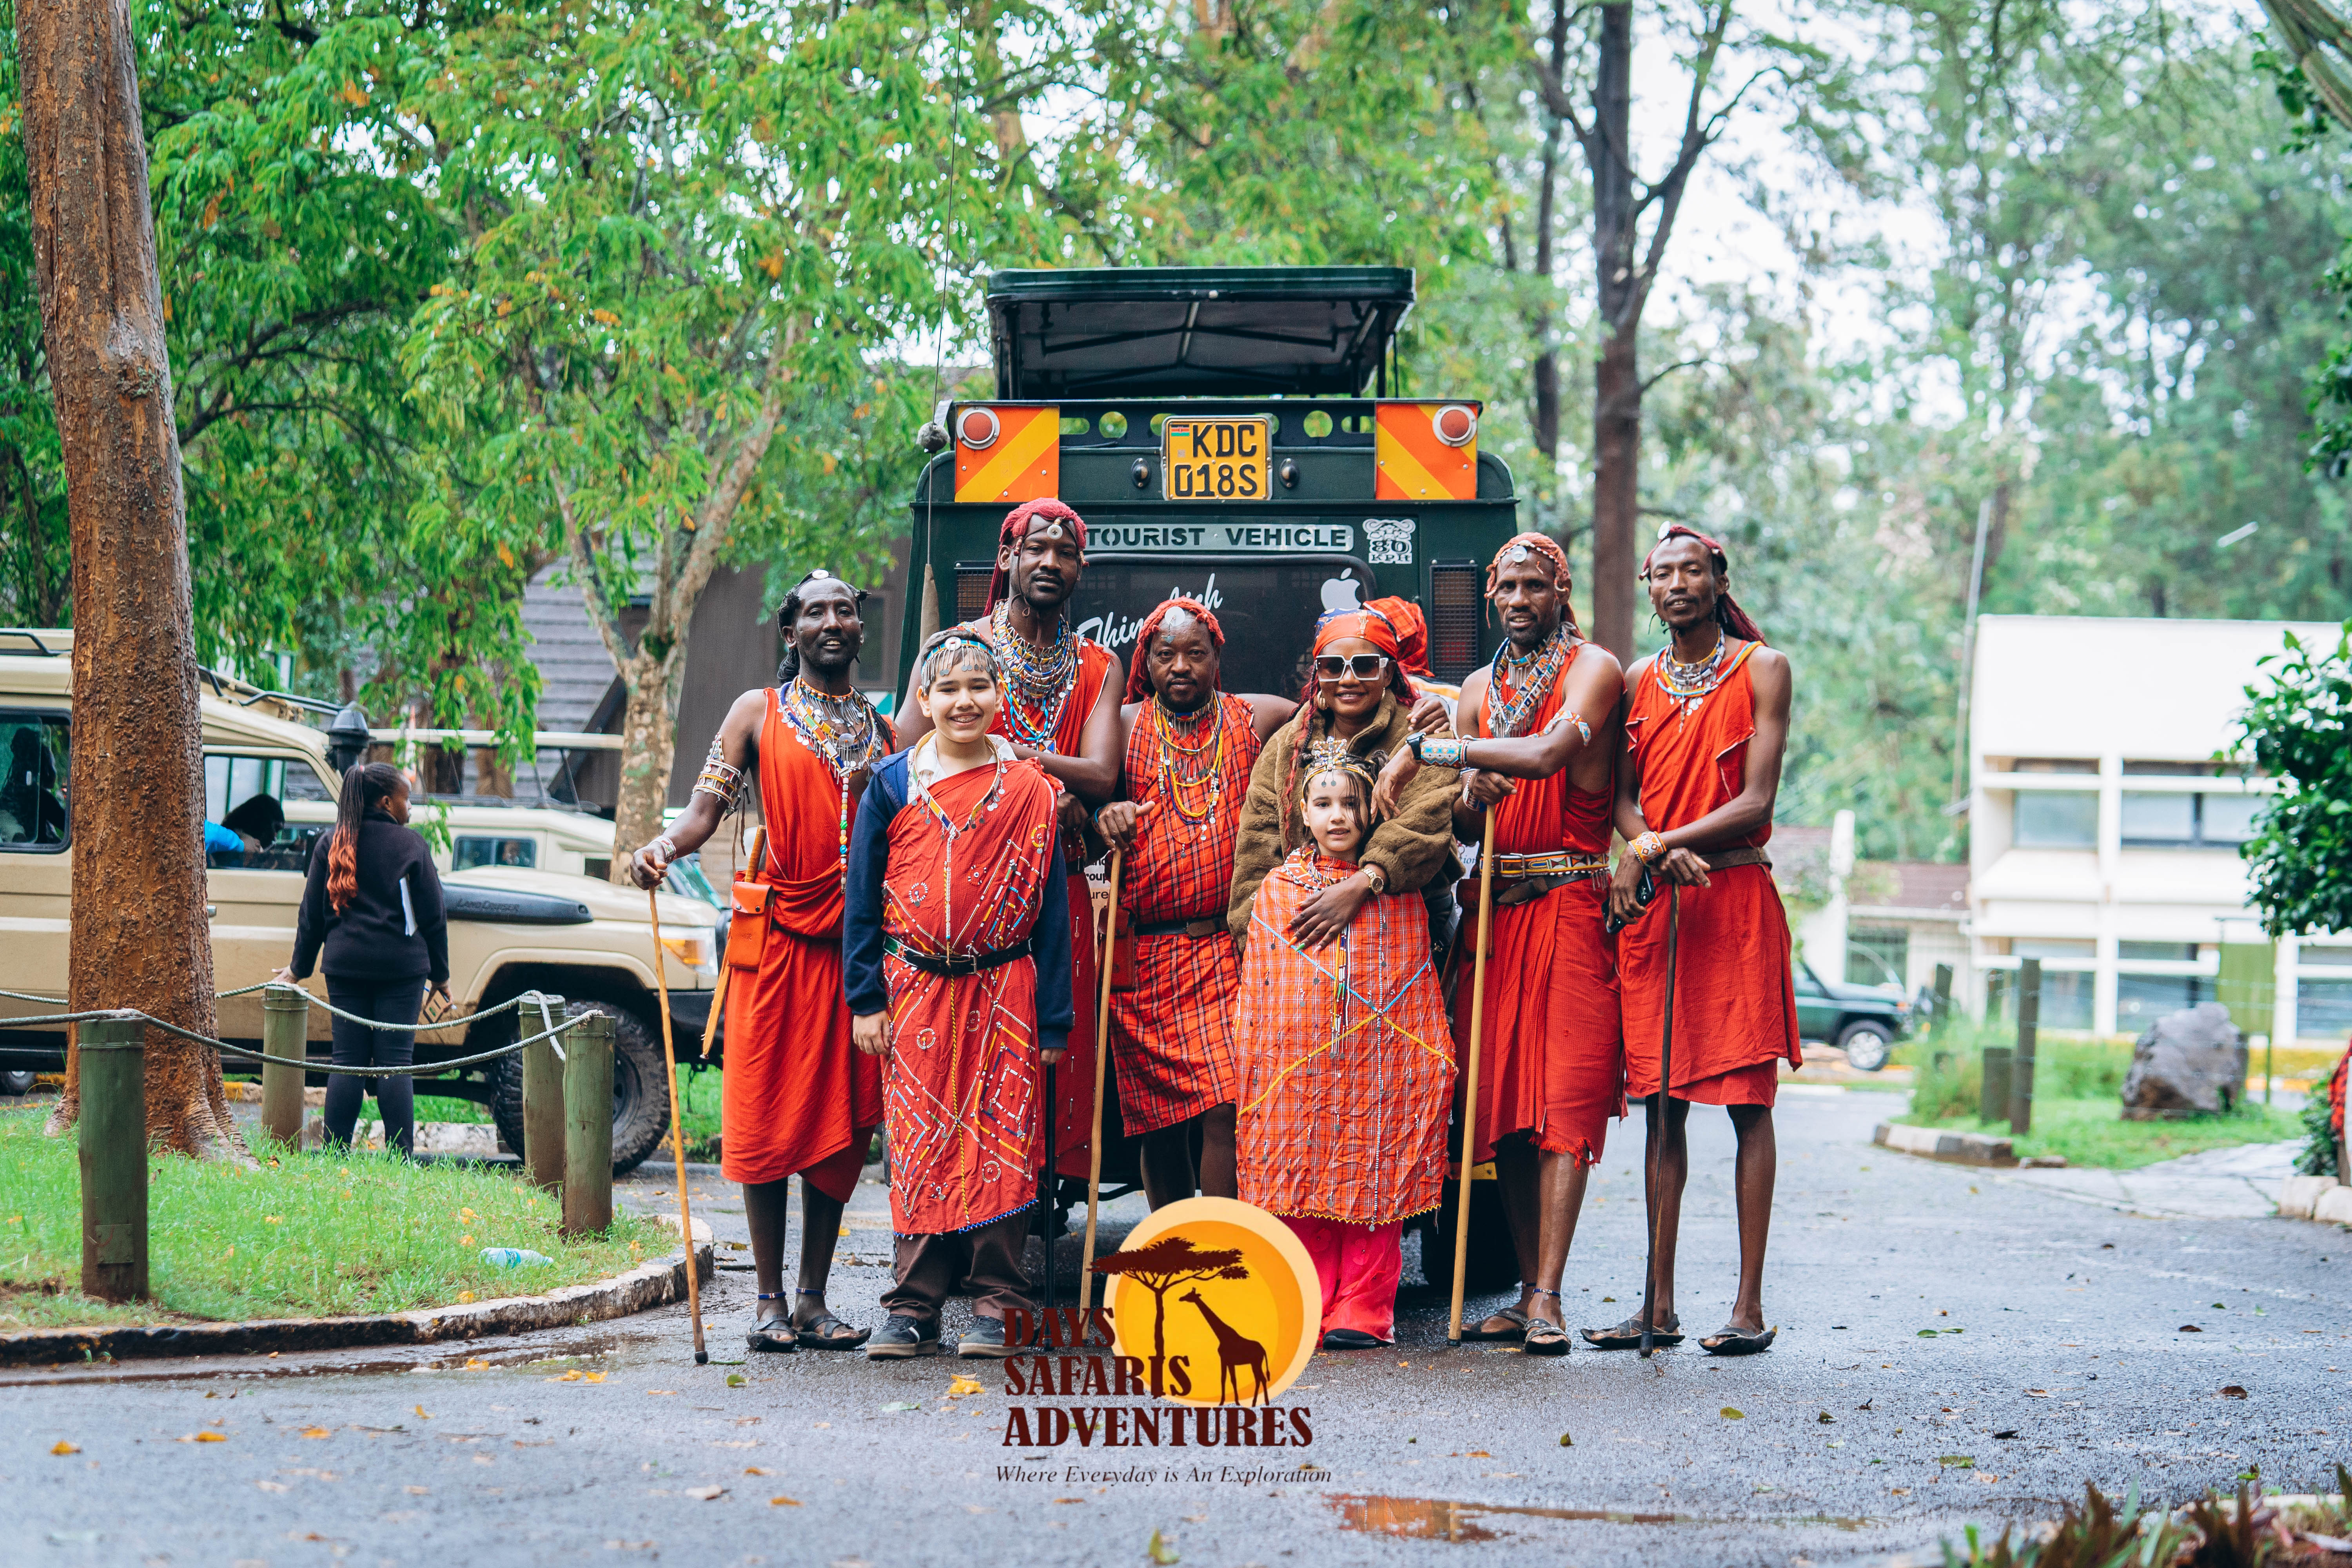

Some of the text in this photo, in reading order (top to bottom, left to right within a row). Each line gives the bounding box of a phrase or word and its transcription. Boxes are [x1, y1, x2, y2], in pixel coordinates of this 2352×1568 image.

[1193, 424, 1257, 457] KDC
[1174, 464, 1258, 497] 018S
[1087, 528, 1347, 546] TOURIST VEHICLE
[1371, 540, 1409, 554] 80
